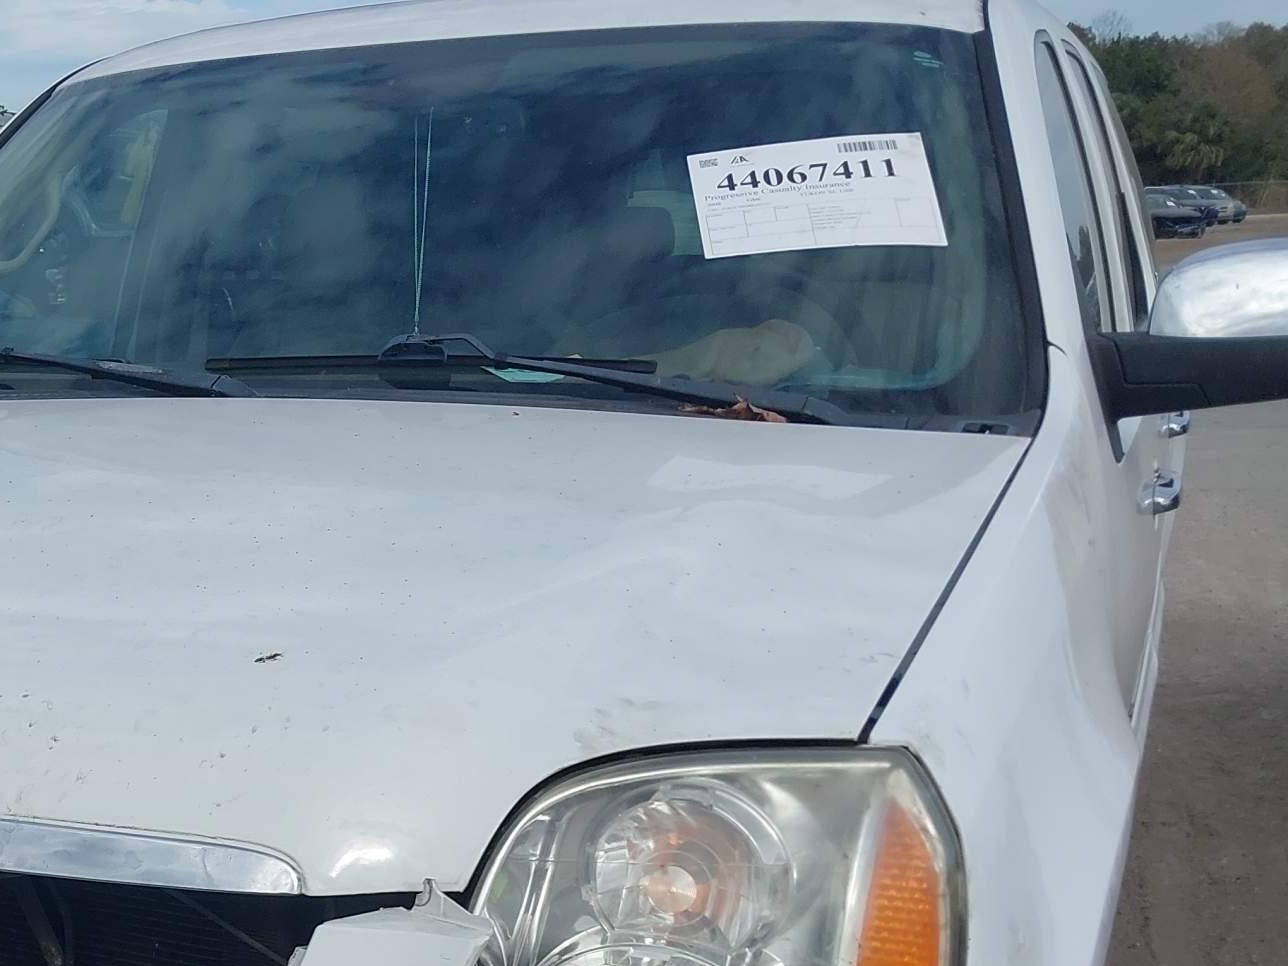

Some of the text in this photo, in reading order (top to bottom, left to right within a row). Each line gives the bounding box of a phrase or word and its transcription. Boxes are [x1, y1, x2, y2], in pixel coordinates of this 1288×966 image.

[716, 158, 897, 192] 44067411
[761, 185, 802, 194] Casualty
[804, 182, 851, 190] Insurance
